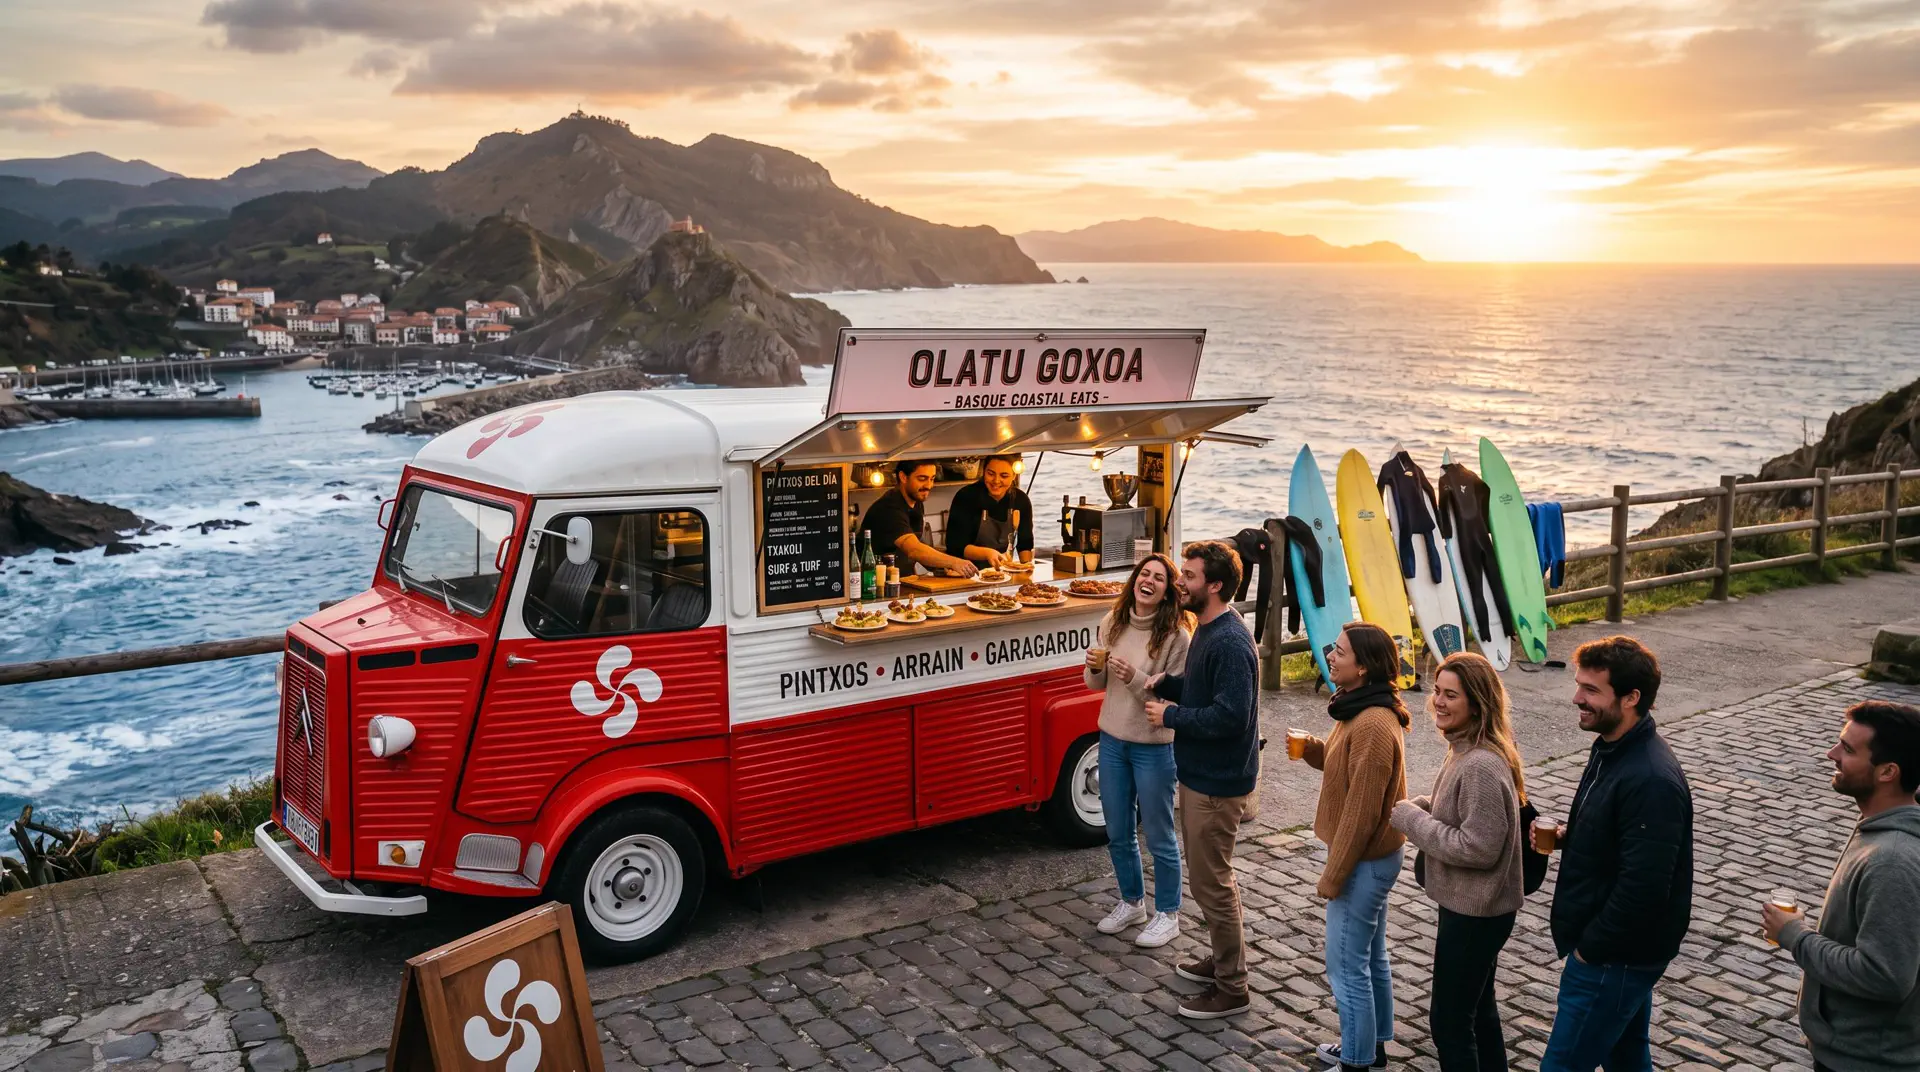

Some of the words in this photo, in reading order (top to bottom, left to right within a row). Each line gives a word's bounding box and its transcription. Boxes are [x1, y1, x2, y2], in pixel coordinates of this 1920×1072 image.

[908, 348, 1026, 389] OLATU
[1035, 347, 1143, 385] GOXOA
[954, 393, 1008, 410] BASQUE
[1010, 392, 1066, 407] COASTAL
[1070, 391, 1100, 405] EATS
[804, 475, 821, 487] DEL
[822, 472, 838, 485] DÍA
[767, 543, 803, 557] TXAKOLI
[767, 563, 790, 576] SURF
[791, 563, 798, 573] &
[800, 560, 821, 572] TURF
[780, 661, 869, 699] PINTXOS
[891, 646, 964, 681] ARRAIN
[985, 627, 1091, 665] GARAGARDO
